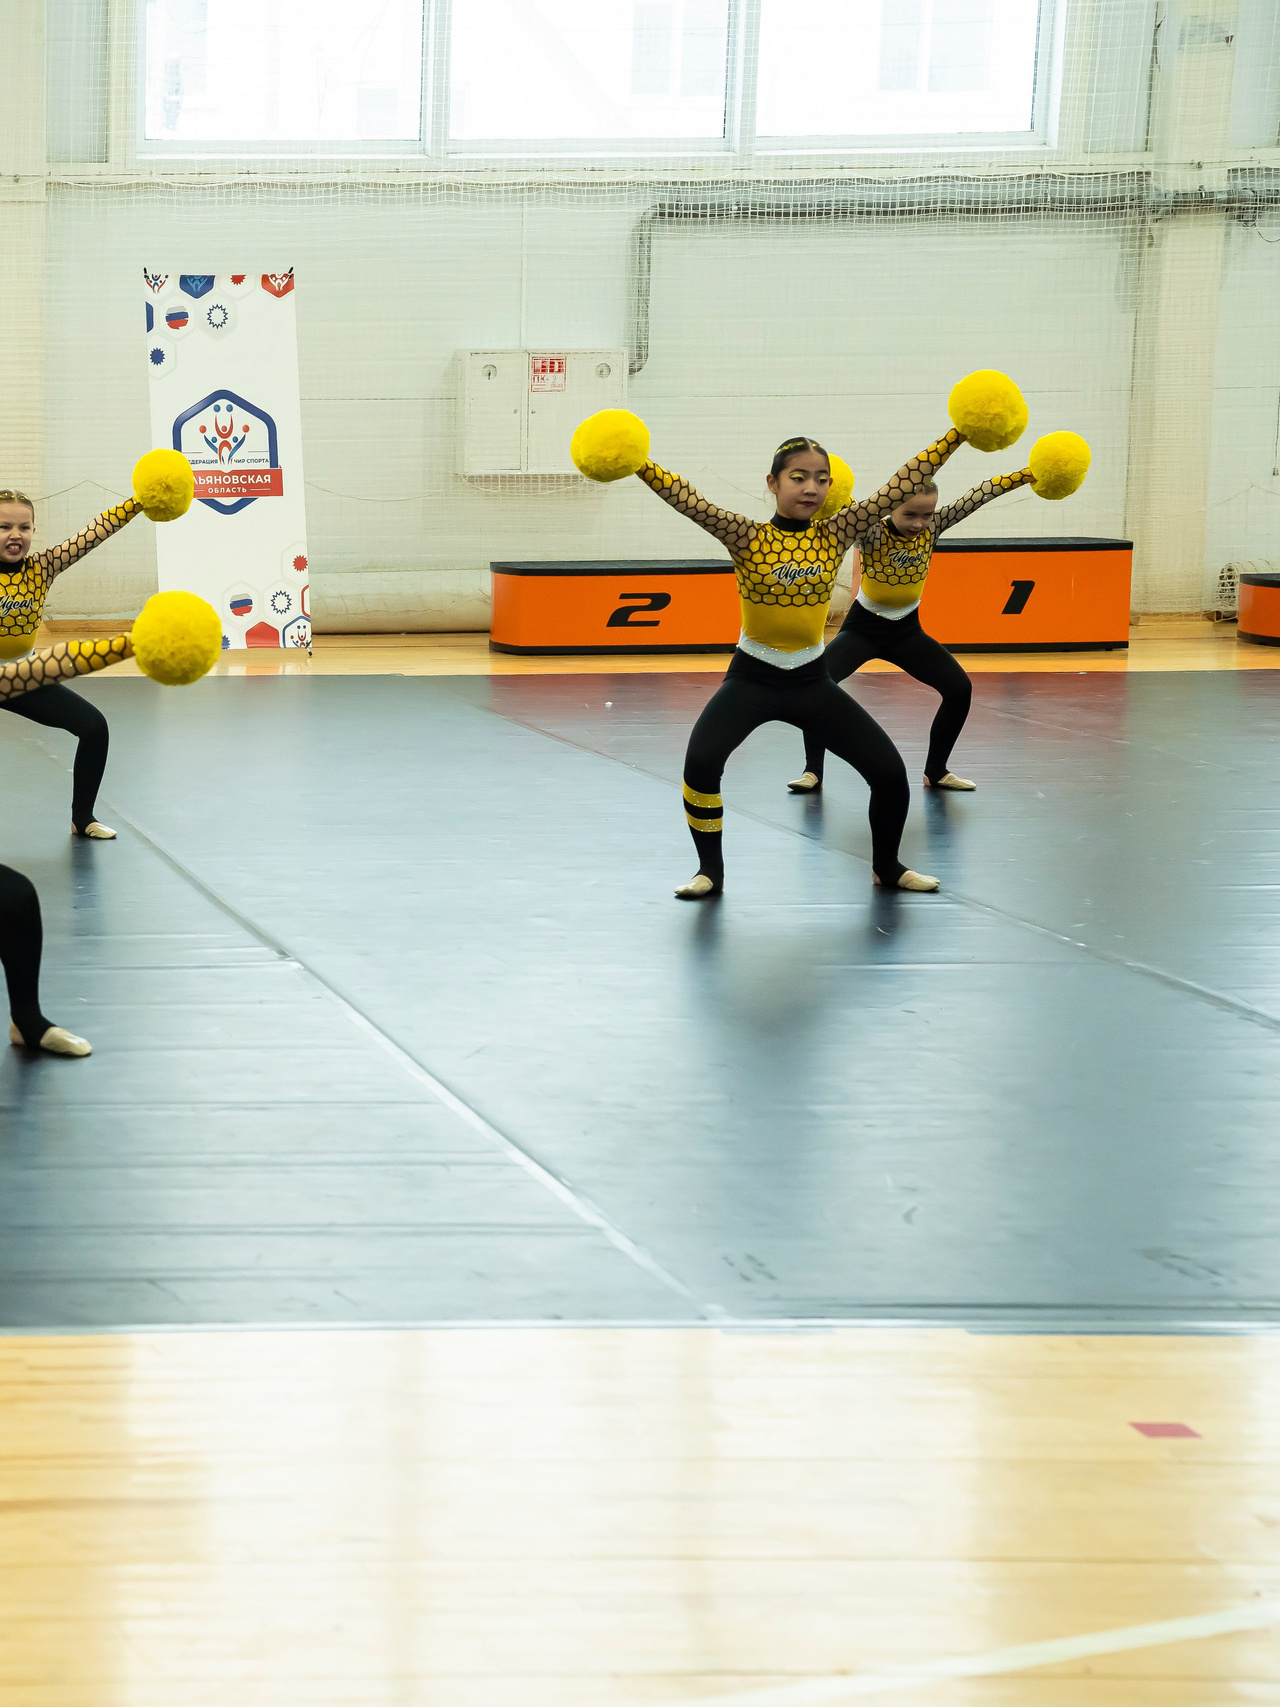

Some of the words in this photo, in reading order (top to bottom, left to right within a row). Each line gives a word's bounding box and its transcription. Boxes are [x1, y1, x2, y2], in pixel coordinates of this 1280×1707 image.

[193, 474, 271, 485] ЬЯНОВСКАЯ
[606, 592, 672, 627] 2
[1001, 580, 1035, 614] 1
